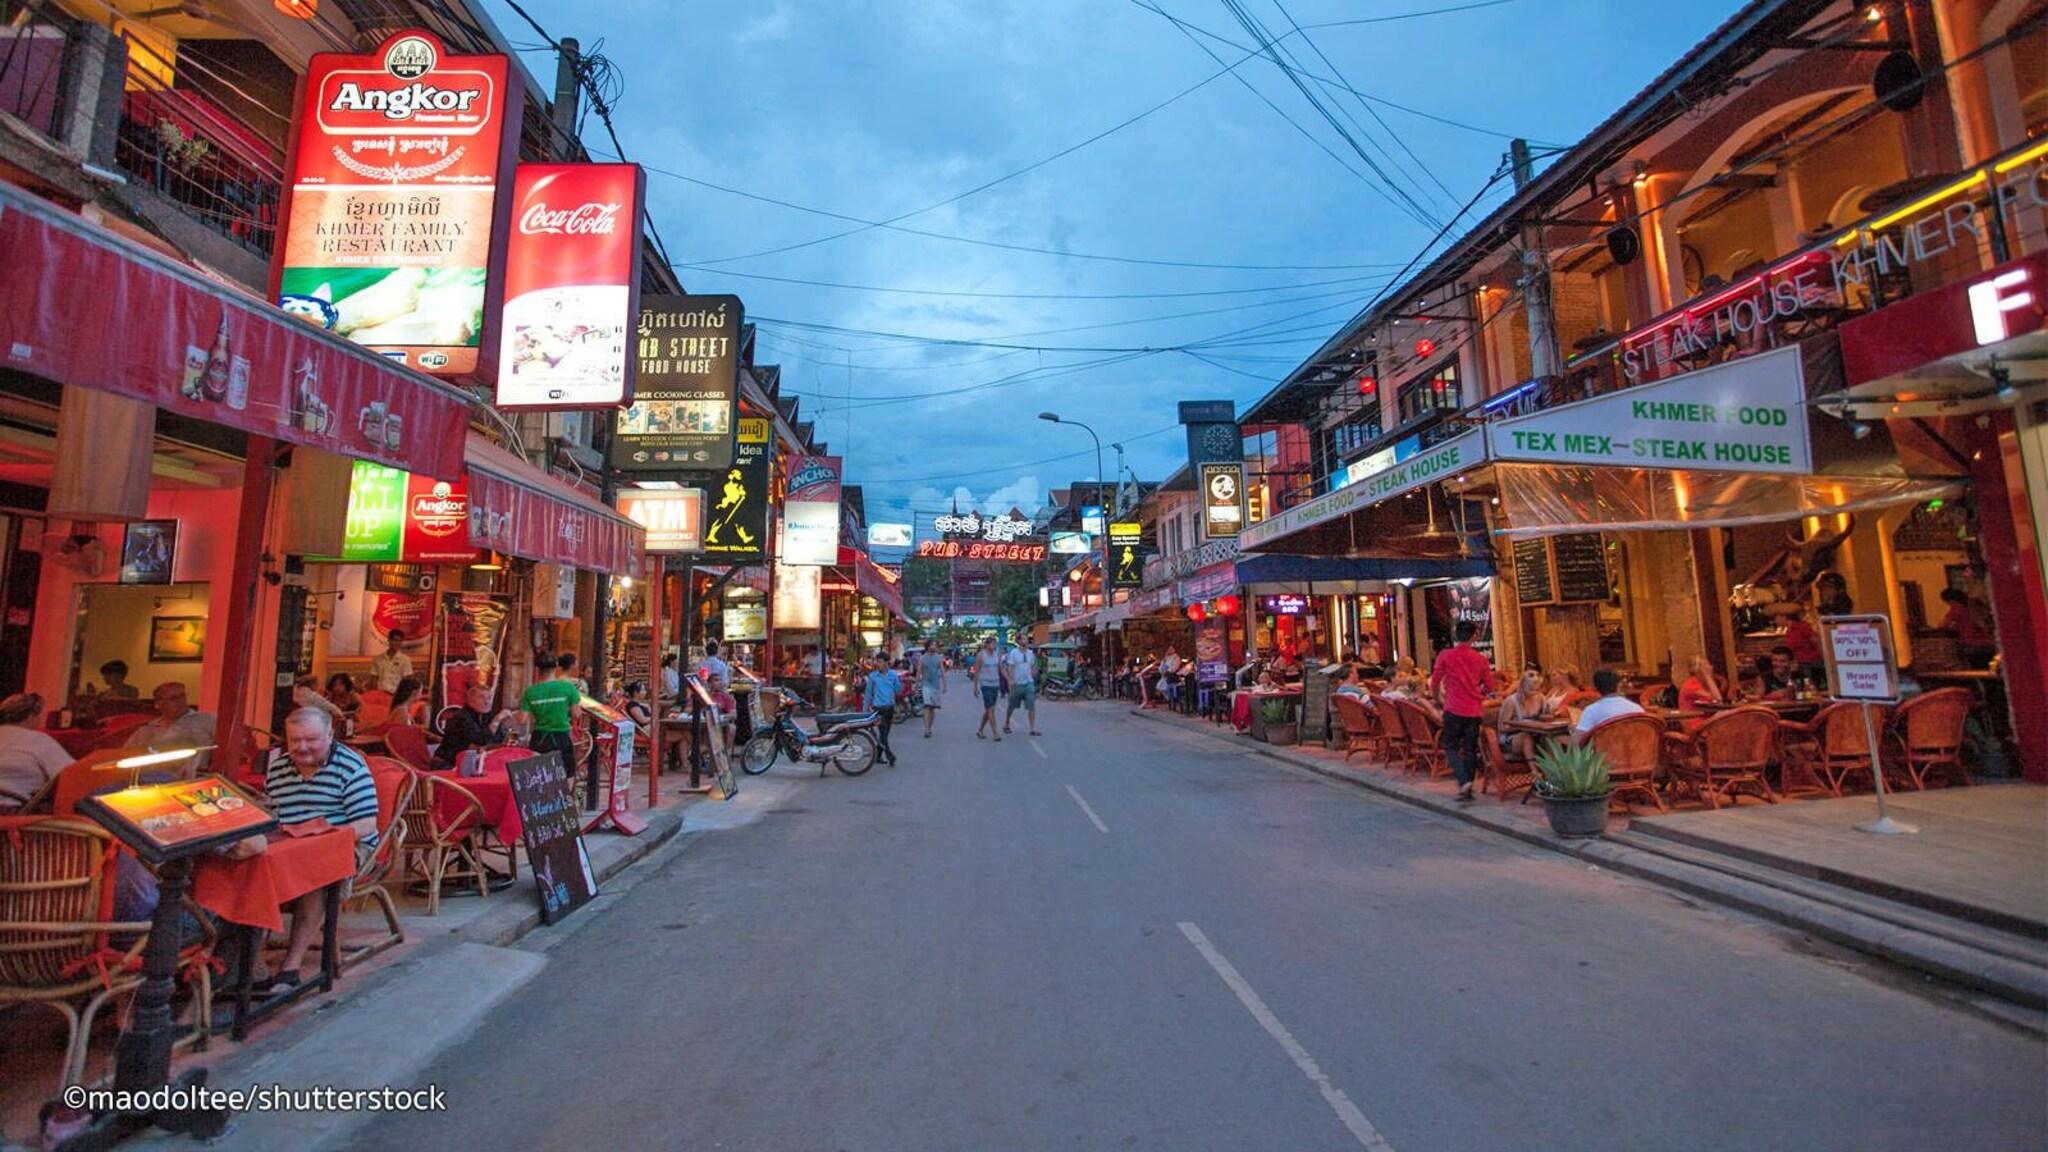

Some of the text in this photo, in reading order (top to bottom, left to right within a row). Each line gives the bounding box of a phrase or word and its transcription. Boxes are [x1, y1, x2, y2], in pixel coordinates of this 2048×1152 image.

[331, 83, 480, 119] Angkor
[315, 221, 467, 236] KHMER FAMILY
[519, 203, 623, 235] Coca-Cola
[322, 239, 457, 253] RESTAURANT
[1623, 200, 1982, 378] STEAK HOUSE KHMER
[670, 337, 729, 358] STREET
[642, 359, 711, 374] FOOD HOUSE
[654, 391, 691, 399] COOKING
[693, 391, 725, 399] CLASSES
[1632, 400, 1787, 426] KHMER FOOD
[739, 444, 763, 455] Idea
[1512, 431, 1557, 452] TEX
[1564, 433, 1613, 454] MEX
[1633, 438, 1707, 460] STEAK
[1715, 443, 1791, 464] HOUSE
[1297, 502, 1328, 522] KHMER
[1328, 491, 1354, 512] FOOD
[1368, 471, 1407, 498] STEAK
[1411, 447, 1460, 481] HOUSE
[416, 500, 466, 514] Angkor
[628, 499, 687, 530] ATM
[920, 541, 1044, 560] PUB STREET
[1846, 649, 1869, 657] OFF
